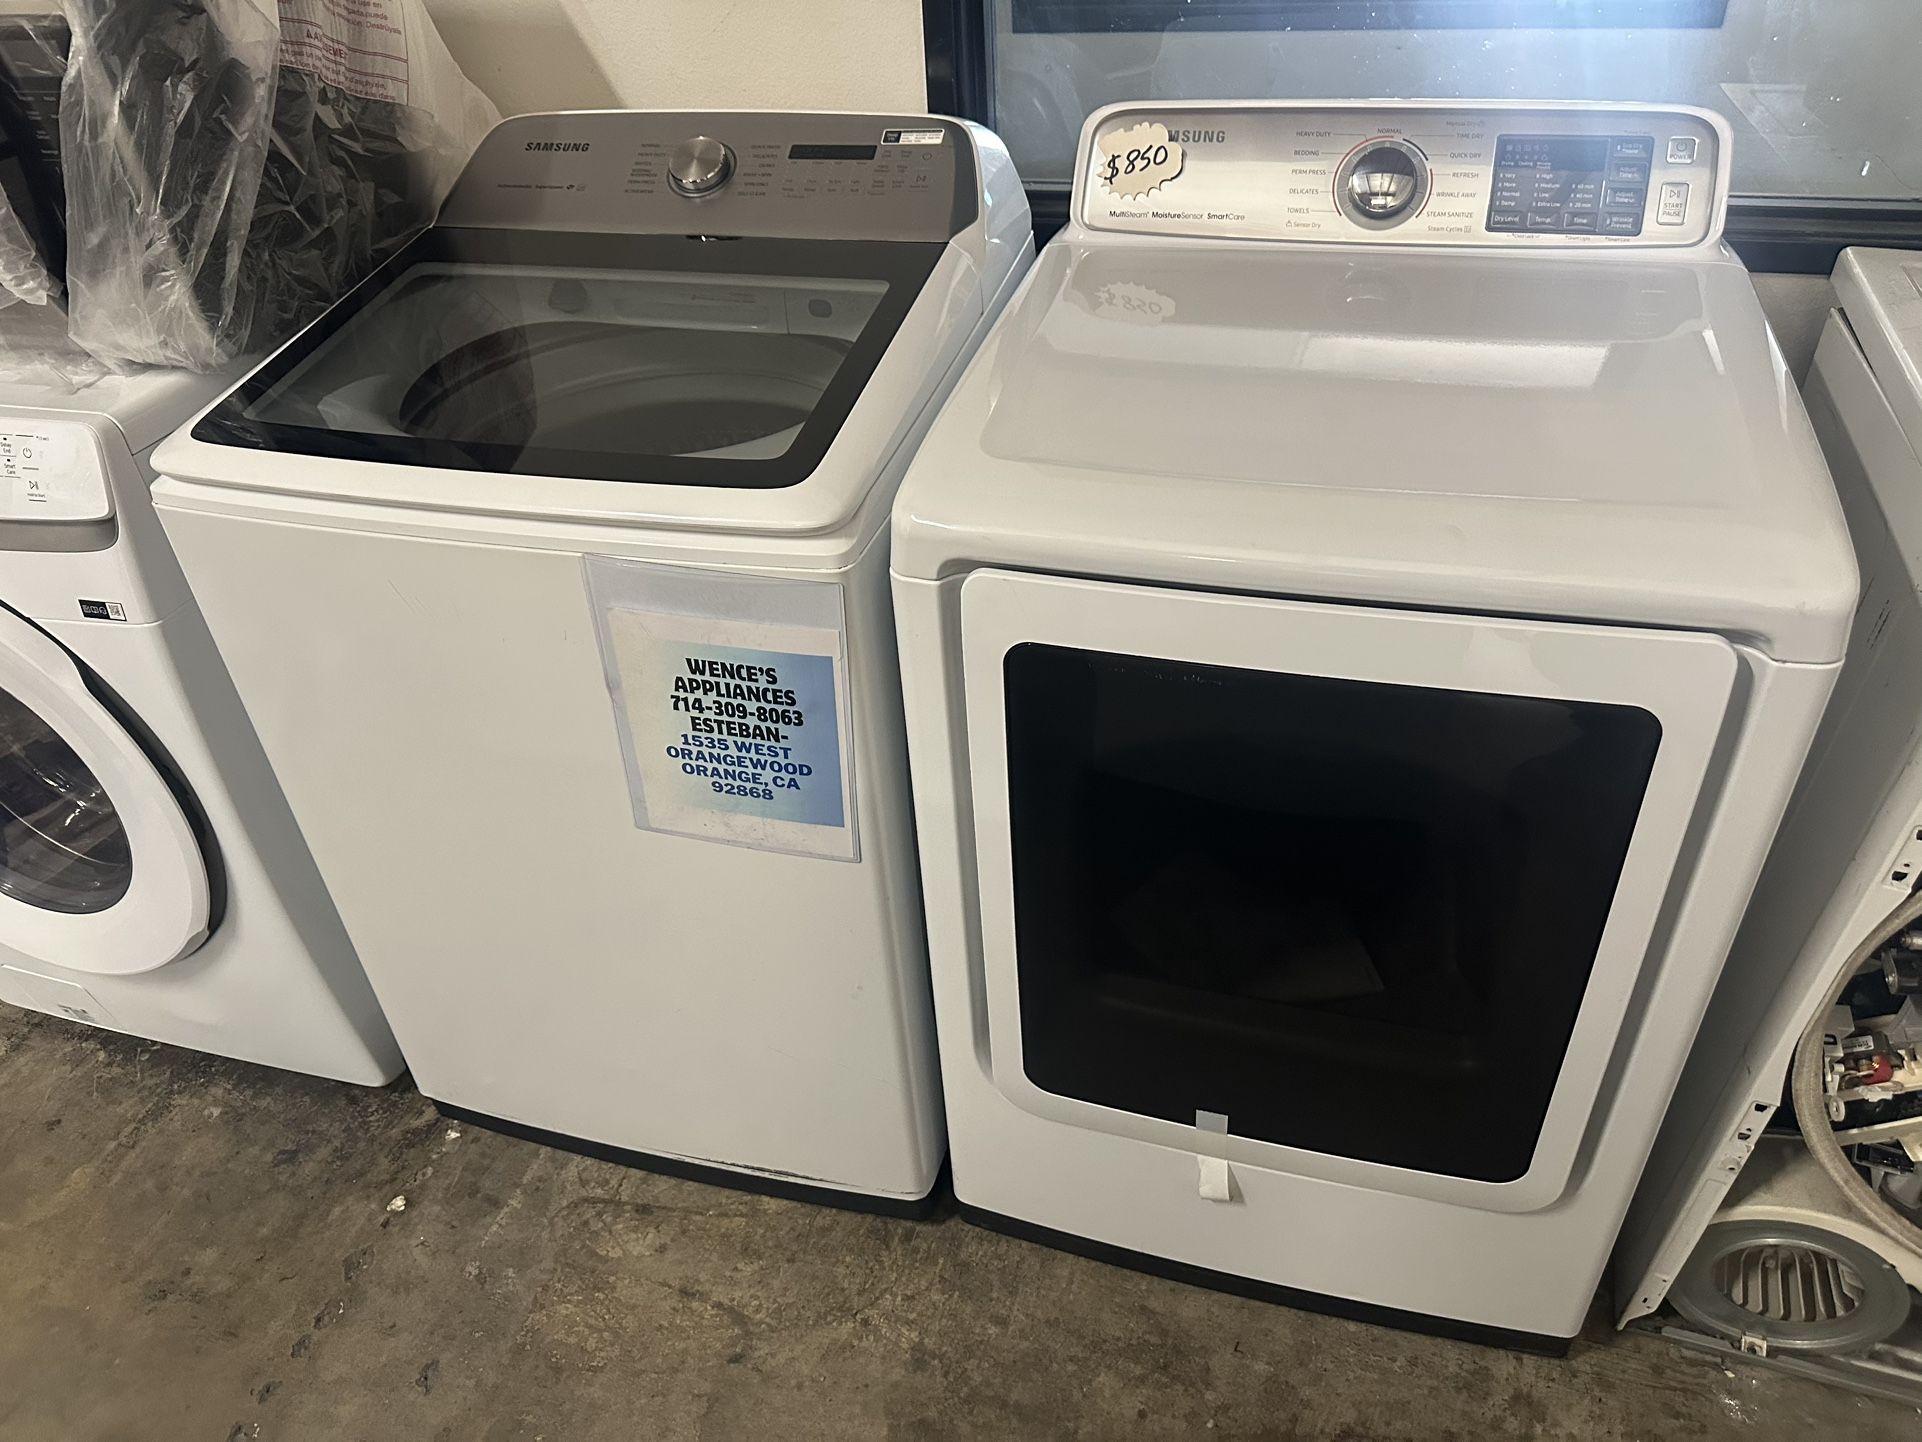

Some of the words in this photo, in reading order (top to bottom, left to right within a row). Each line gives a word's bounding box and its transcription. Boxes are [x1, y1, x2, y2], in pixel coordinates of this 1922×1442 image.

[525, 142, 590, 152] SAMSUNG
[1168, 129, 1226, 144] MSUNG
[1104, 145, 1168, 185] $850
[1152, 211, 1203, 220] MoistureSensor
[1207, 212, 1246, 221] SmartCare
[1312, 222, 1322, 230] Dry
[1446, 226, 1463, 234] Cycles
[686, 658, 778, 684] WENCE'S
[674, 676, 796, 706] APPLIANCES
[670, 695, 804, 726] 714-309-8063
[690, 716, 788, 743] ESTEBAN-
[681, 734, 730, 750] 1535
[732, 740, 792, 760] WEST
[666, 746, 812, 776] ORANGEWOOD
[682, 763, 769, 788] ORANGE,
[772, 776, 800, 790] CA
[711, 781, 774, 800] 92868
